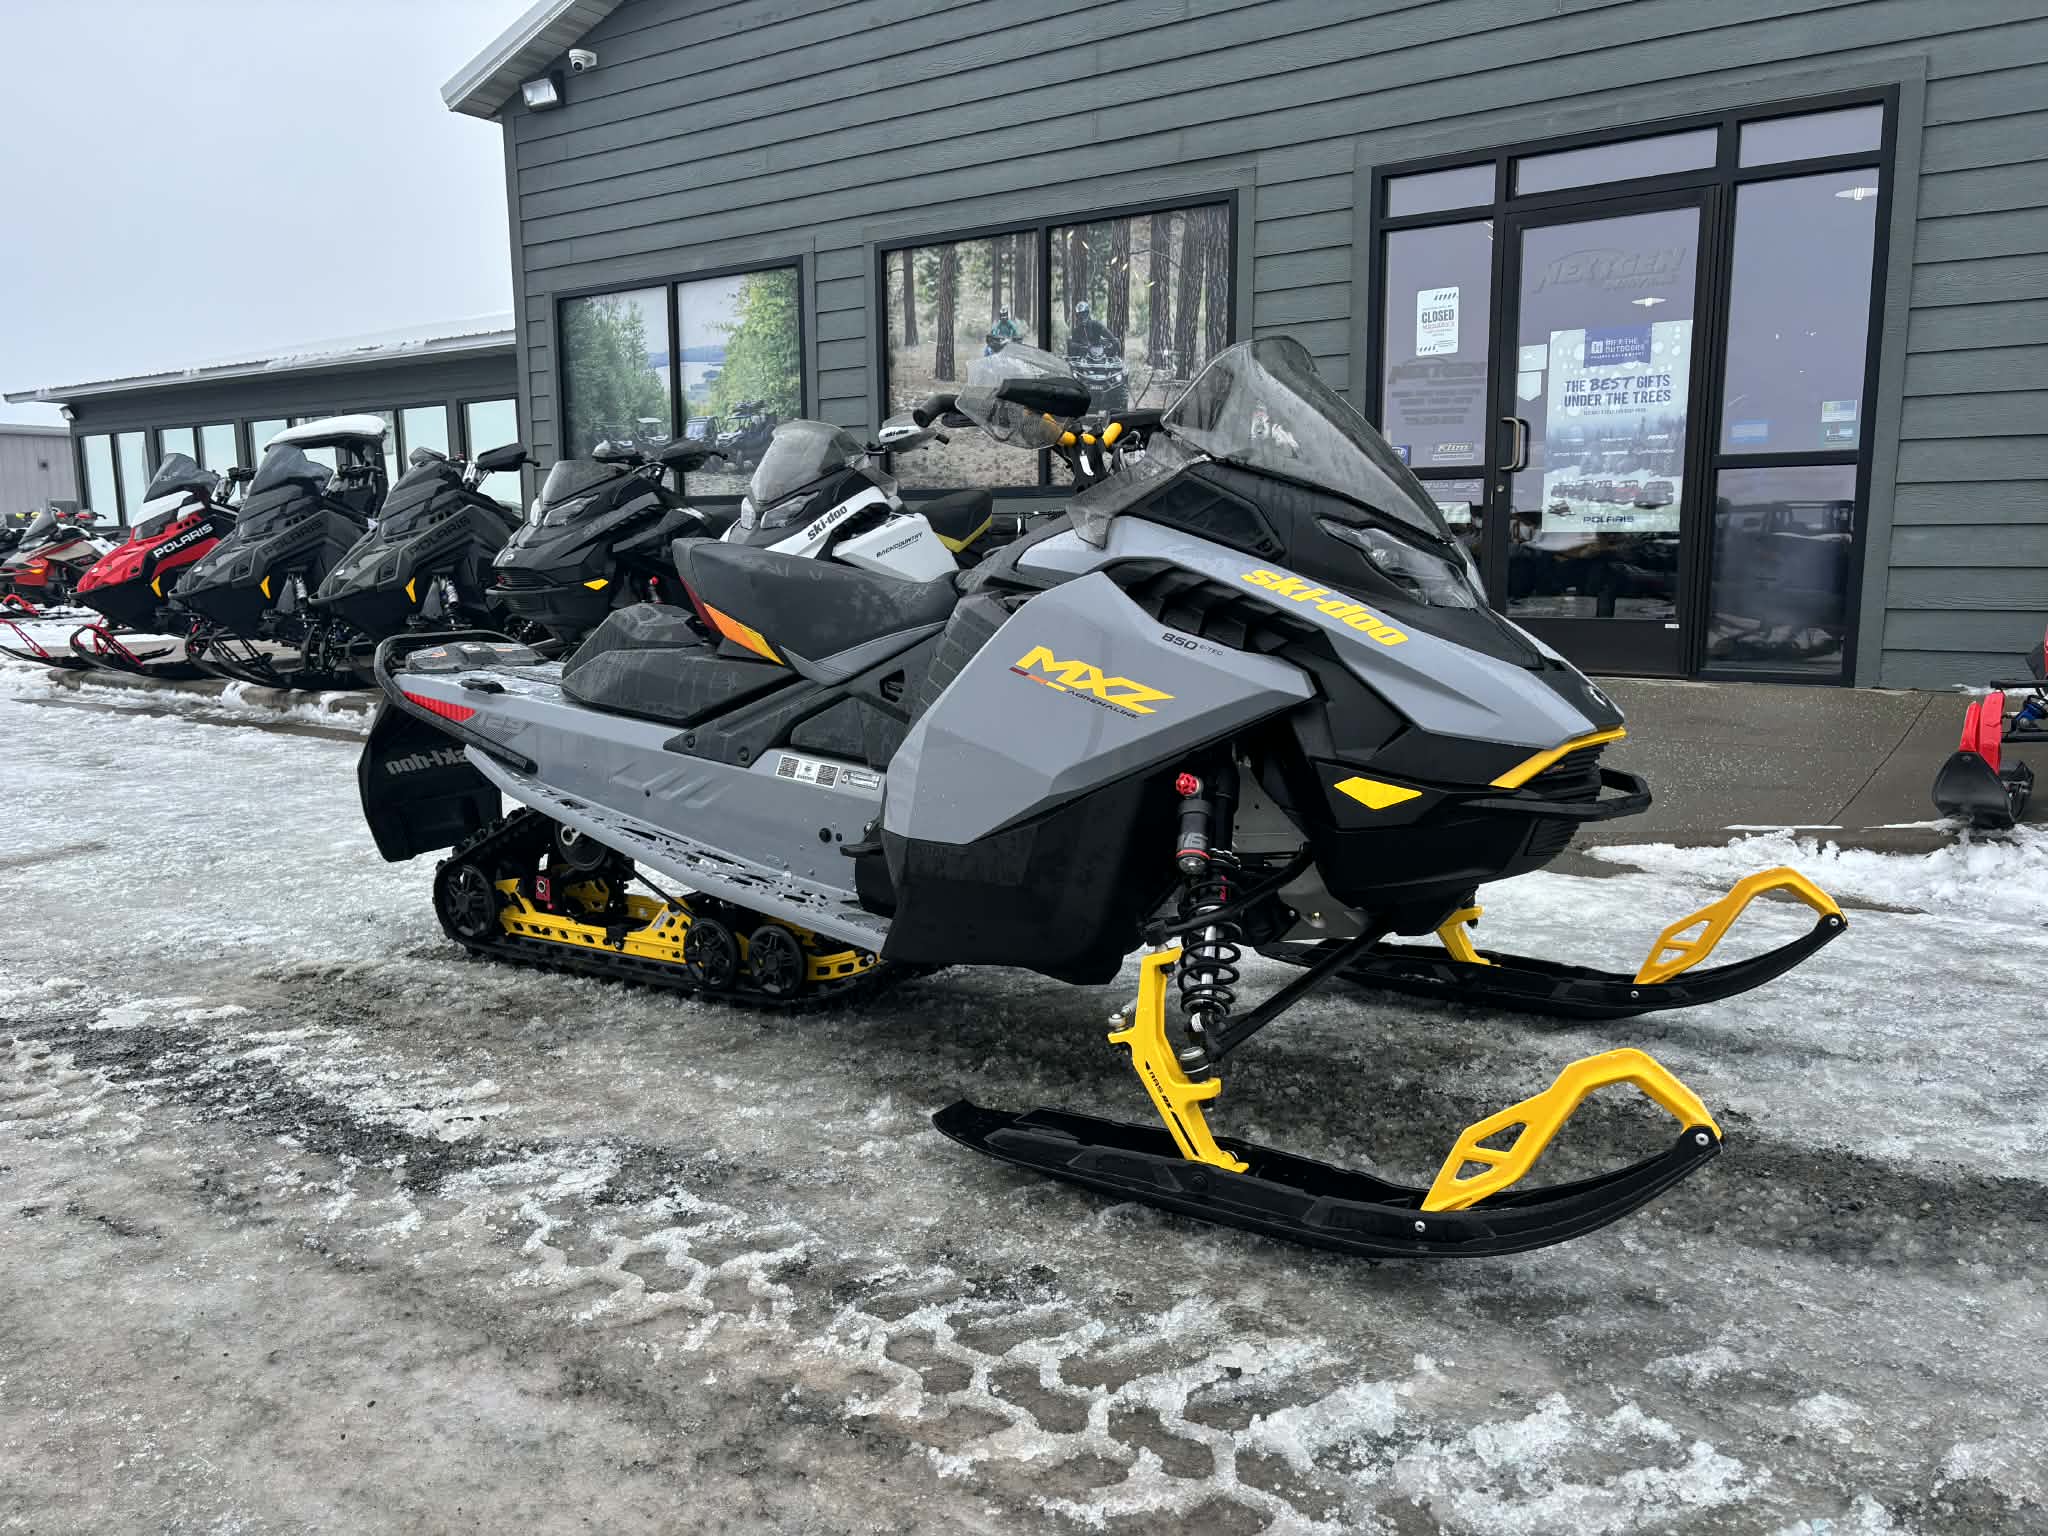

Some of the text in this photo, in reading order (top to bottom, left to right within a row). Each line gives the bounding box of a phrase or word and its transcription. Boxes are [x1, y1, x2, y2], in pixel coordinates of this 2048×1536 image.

[1421, 309, 1454, 323] CLOSED
[1565, 374, 1671, 392] THE BEST GIFTS
[1564, 390, 1671, 407] UNDER THE TREES
[807, 505, 848, 541] ski-doo
[1583, 515, 1634, 523] POLARIS
[153, 523, 213, 559] POLARIS
[265, 518, 322, 555] POLARIS
[876, 532, 923, 558] BACKCOUNTRY
[1240, 569, 1409, 646] ski-doo
[1161, 632, 1224, 656] 850 E-TEC
[1016, 645, 1176, 714] MXZ
[1067, 689, 1140, 719] ADRENALINE
